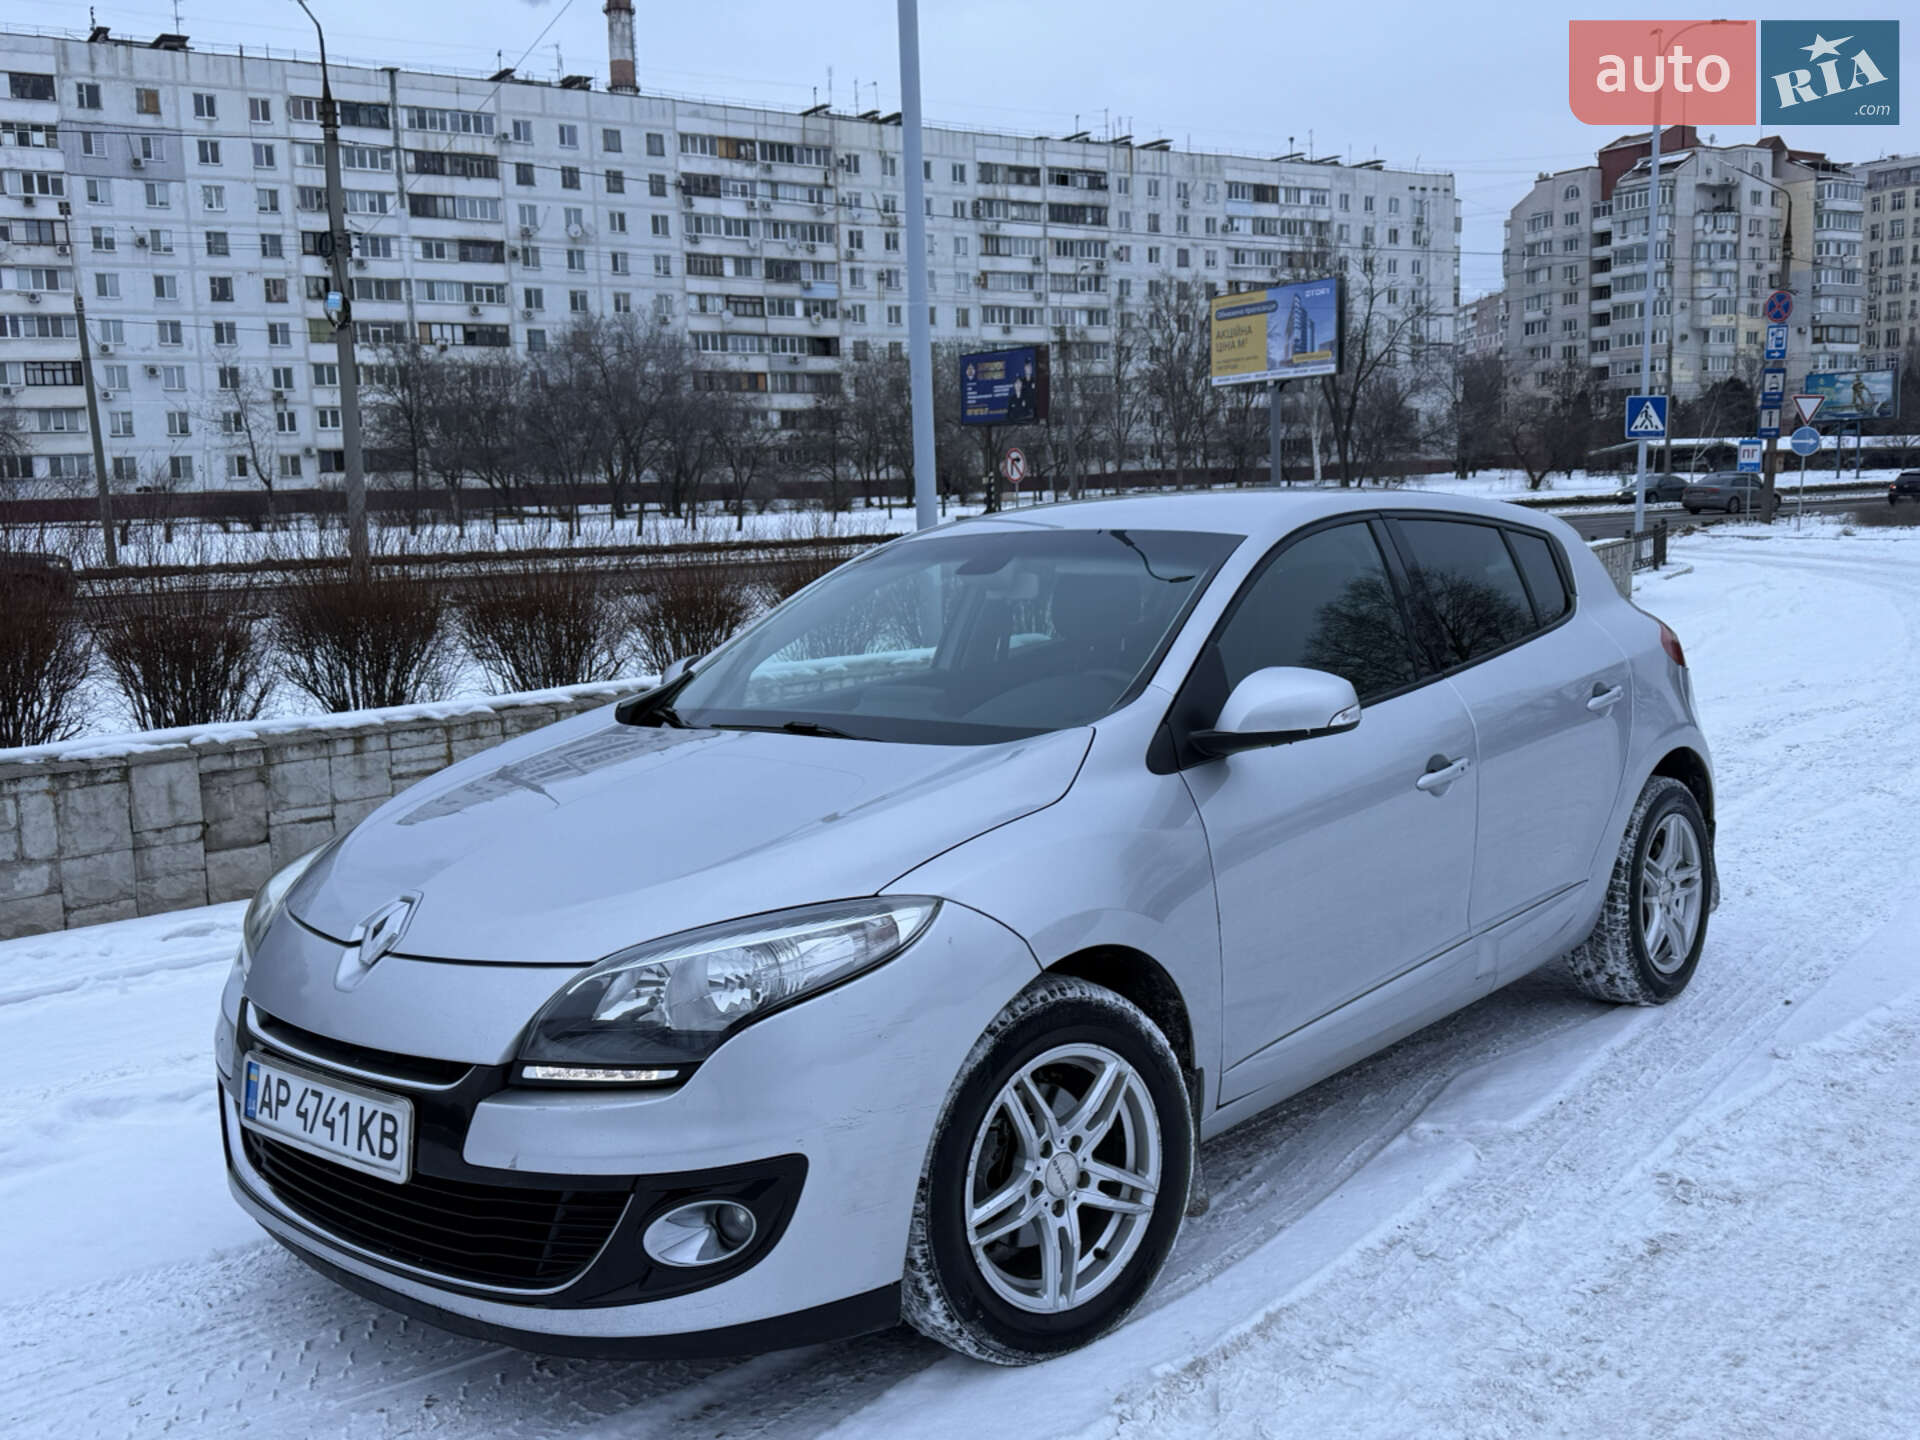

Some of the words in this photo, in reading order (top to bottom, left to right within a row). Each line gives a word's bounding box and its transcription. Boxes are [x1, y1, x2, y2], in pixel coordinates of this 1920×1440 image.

[259, 1074, 291, 1121] AP
[296, 1087, 349, 1147] 4741
[357, 1105, 398, 1161] KB
